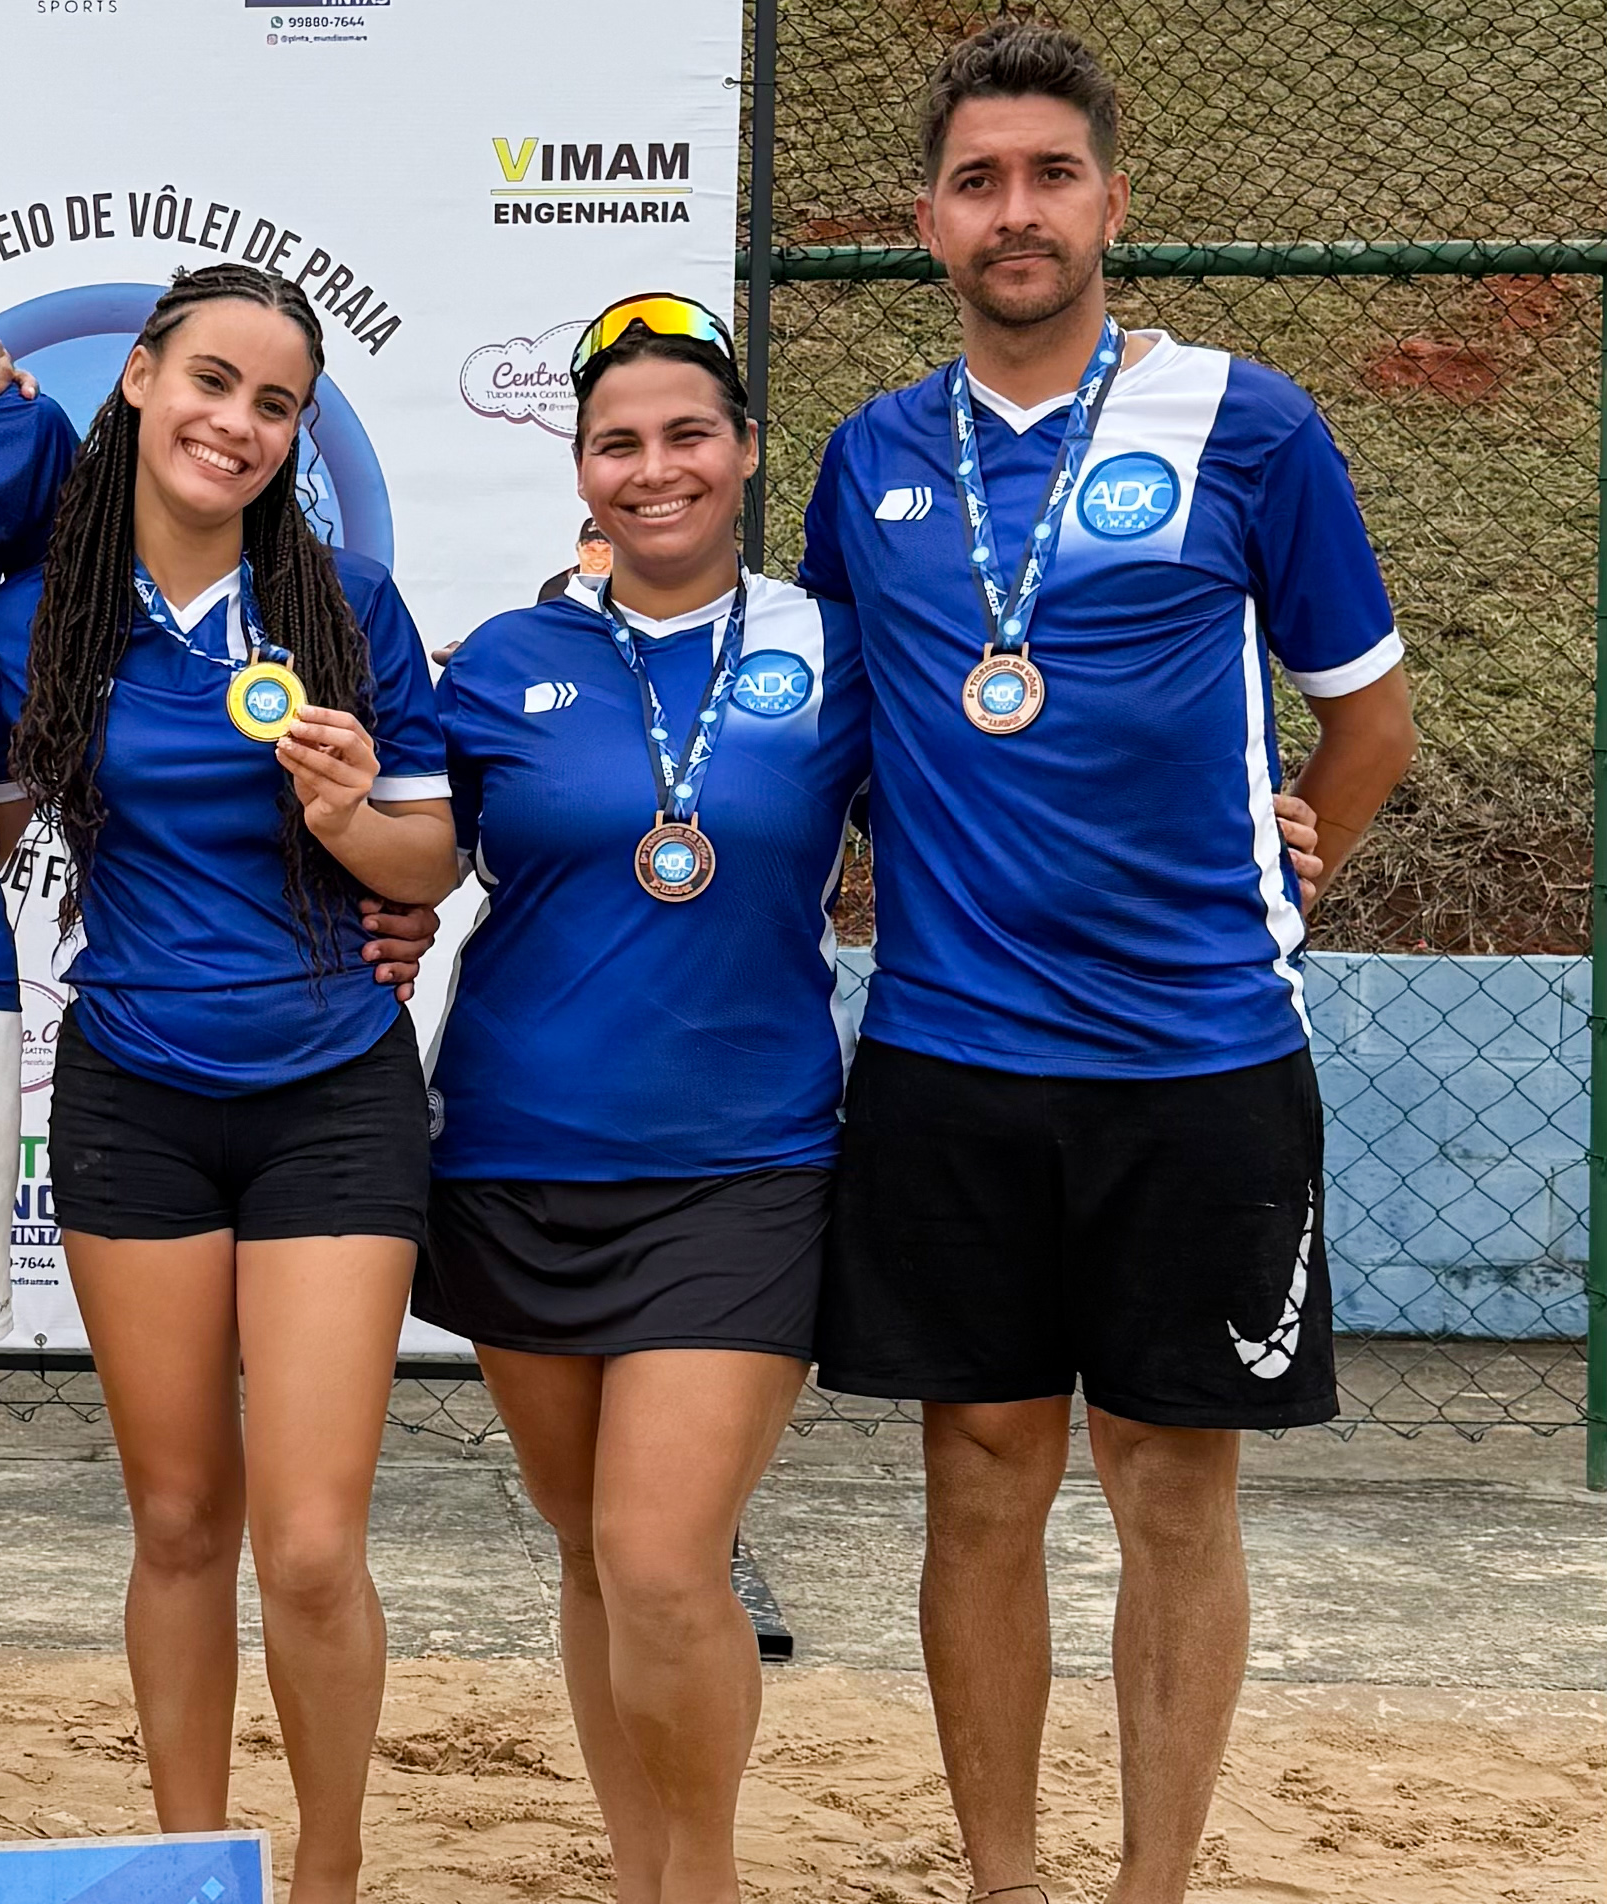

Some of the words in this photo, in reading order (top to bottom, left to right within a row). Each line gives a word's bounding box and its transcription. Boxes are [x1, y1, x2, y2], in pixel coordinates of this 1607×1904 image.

[37, 0, 119, 14] SPORTS
[288, 15, 365, 28] 99880-7644
[492, 137, 690, 182] VIMAM
[494, 201, 690, 225] ENGENHARIA
[66, 192, 115, 242] DE
[128, 184, 241, 253] VÔLEI
[242, 218, 302, 275] DE
[294, 247, 402, 356] PRAIA
[492, 361, 570, 389] Centro
[1084, 481, 1173, 514] ADC
[733, 672, 808, 697] ADC
[655, 854, 694, 873] ADC
[10, 1256, 56, 1269] -7644
